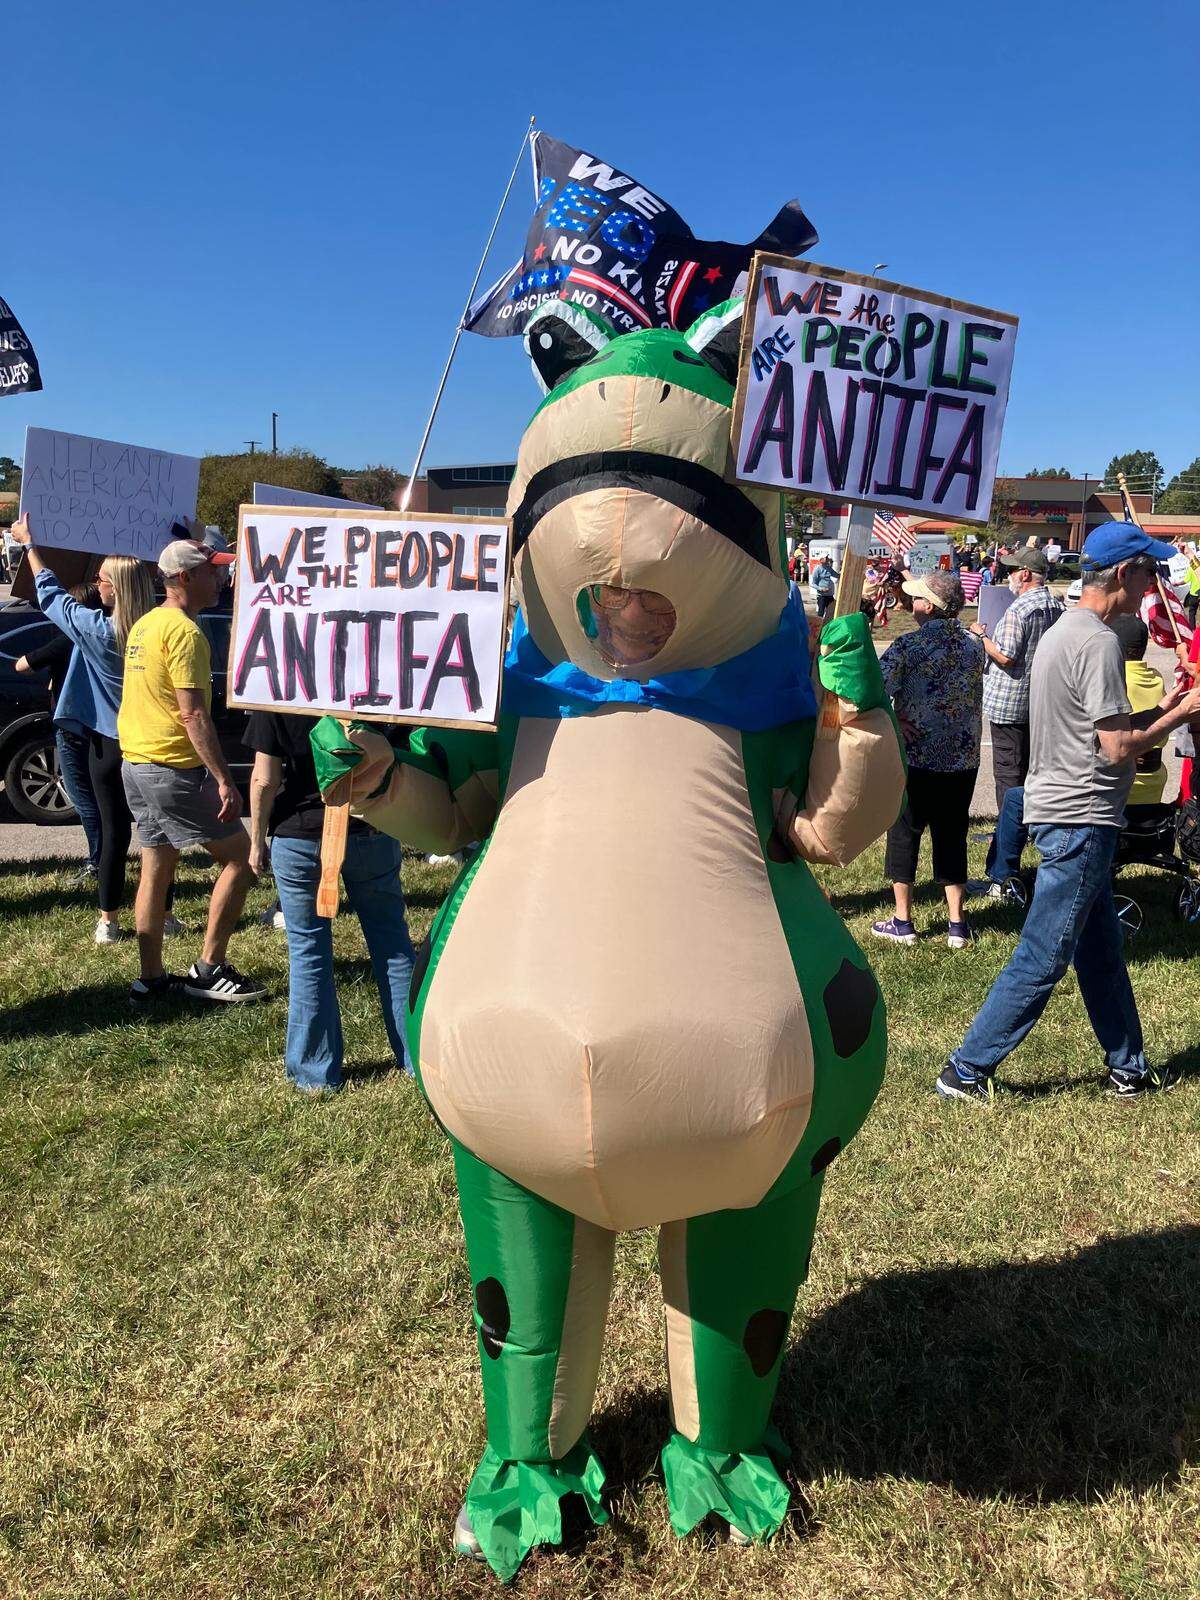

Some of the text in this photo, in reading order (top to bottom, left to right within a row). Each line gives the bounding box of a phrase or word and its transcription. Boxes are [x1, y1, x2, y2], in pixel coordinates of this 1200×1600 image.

[567, 153, 667, 220] WE
[551, 235, 646, 305] NO KI
[570, 289, 642, 331] NO TYRA
[763, 276, 895, 334] WE the
[0, 361, 29, 388] ELIEFS
[751, 325, 795, 381] ARE
[802, 312, 1005, 395] PEOPLE
[52, 436, 173, 482] IT IS ANTI
[743, 361, 985, 511] ANTIFA
[26, 465, 175, 507] AMERICAN
[34, 494, 177, 528] TO BOW DOW
[36, 519, 71, 542] TO
[82, 521, 100, 545] A
[245, 526, 501, 592] WE THE PEOPLE
[251, 584, 312, 607] ARE
[234, 607, 484, 712] ANTIFA
